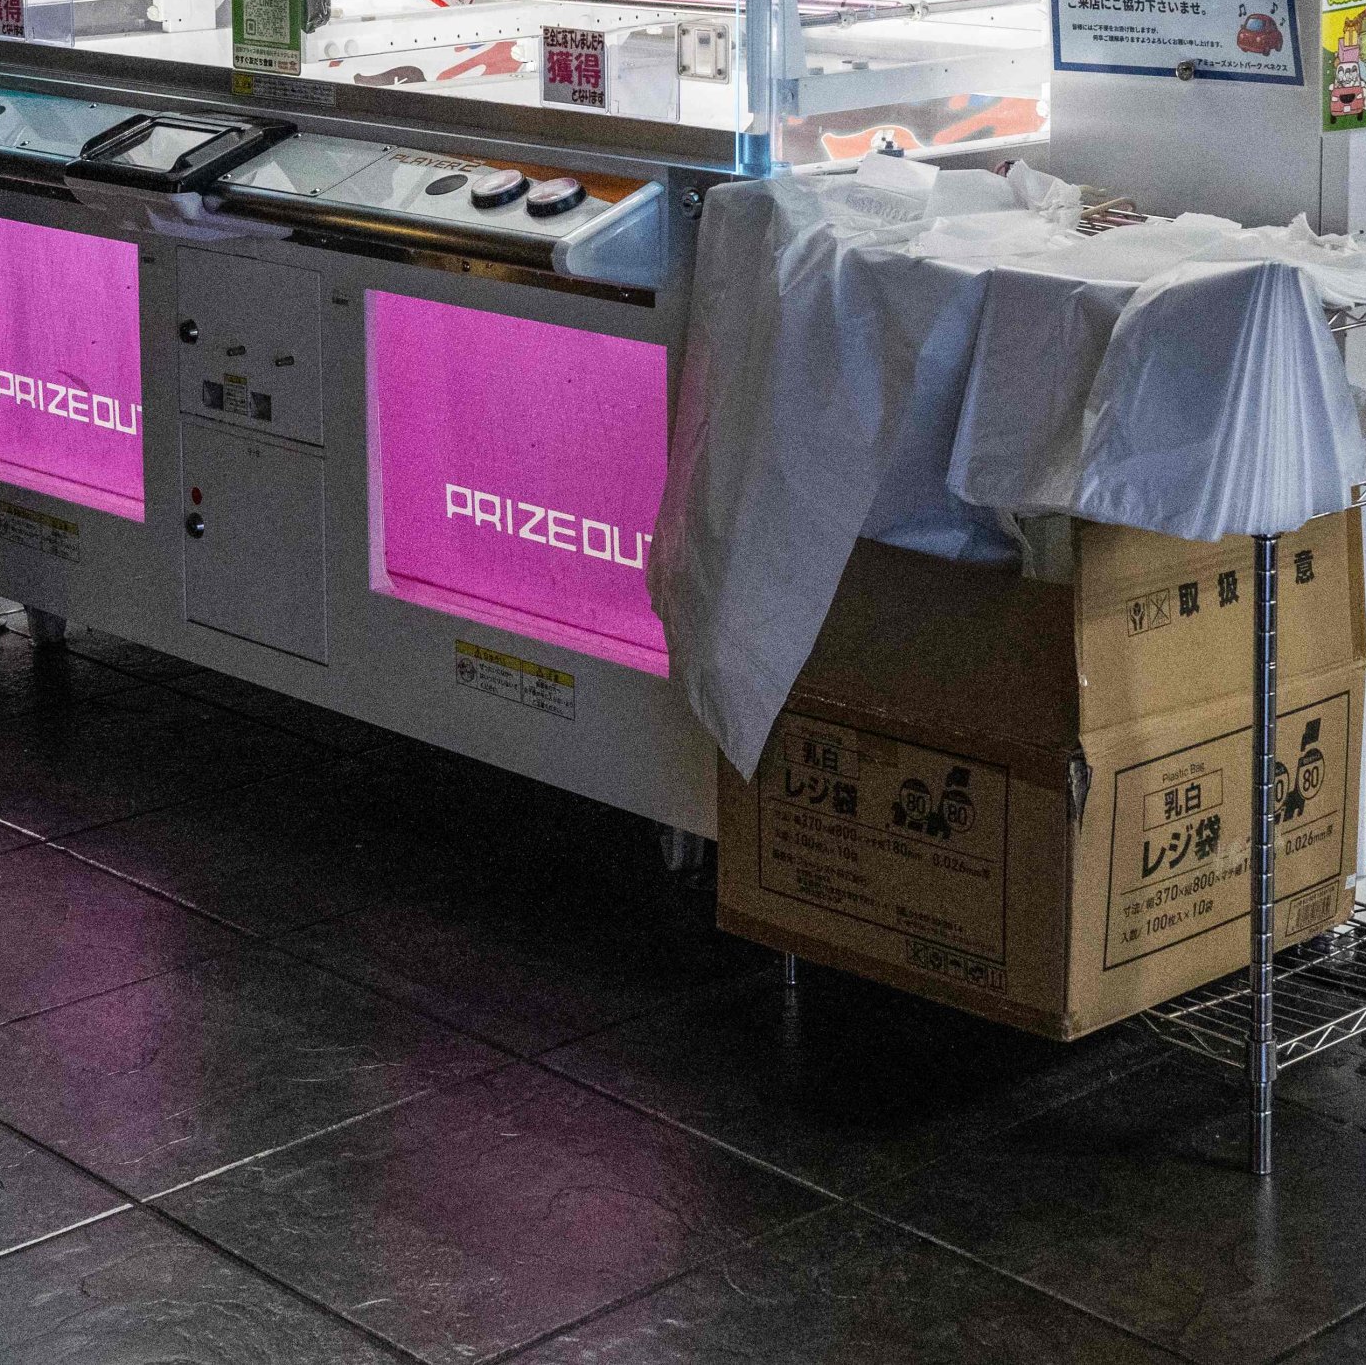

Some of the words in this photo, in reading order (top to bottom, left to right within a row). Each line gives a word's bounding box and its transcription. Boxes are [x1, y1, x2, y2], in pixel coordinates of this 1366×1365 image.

[547, 49, 602, 89] 獲得
[571, 88, 606, 106] となります
[388, 153, 460, 171] PLAYER
[1178, 549, 1314, 617] 取扱意
[1162, 768, 1189, 784] Plastic
[1190, 761, 1206, 774] Bag
[1302, 765, 1320, 793] 80
[784, 769, 857, 818] レジ袋
[905, 794, 926, 815] 80
[946, 804, 968, 825] 80
[1163, 782, 1202, 821] 乳白
[1141, 814, 1223, 880] レジ袋
